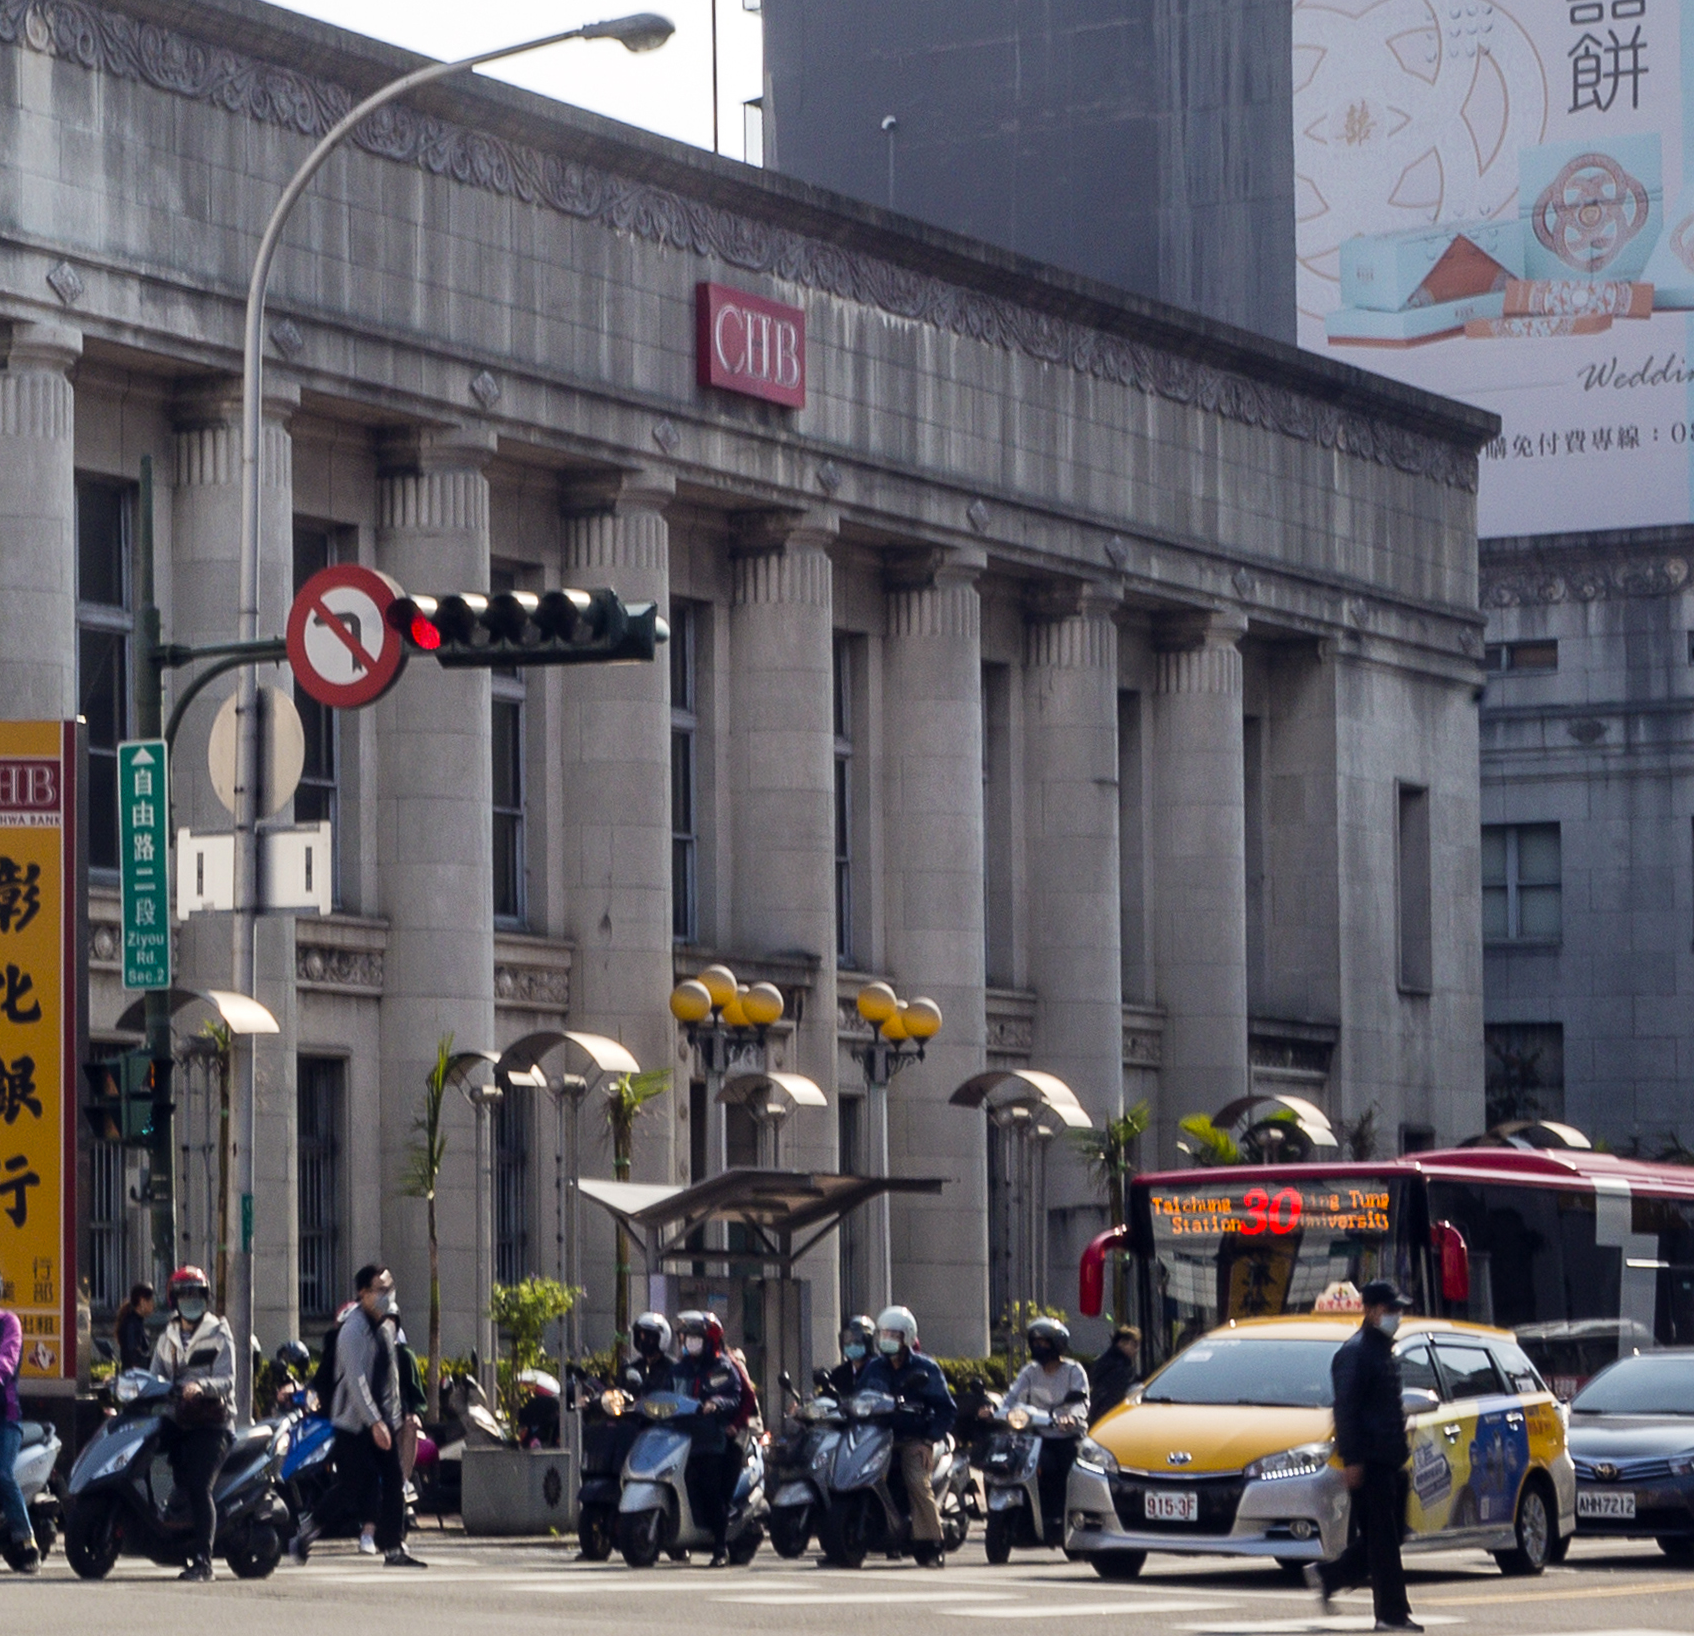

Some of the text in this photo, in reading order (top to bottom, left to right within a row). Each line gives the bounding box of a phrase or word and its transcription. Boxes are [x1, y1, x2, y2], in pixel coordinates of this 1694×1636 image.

[715, 304, 800, 389] CHB
[0, 815, 25, 826] HWA
[30, 815, 61, 825] BANK
[131, 768, 157, 927] 自由路二段
[127, 930, 165, 951] Ziyou
[136, 950, 157, 965] Rd.
[1151, 1196, 1232, 1215] Taichung
[1348, 1189, 1391, 1211] Tung
[1240, 1186, 1303, 1236] 30
[1171, 1215, 1243, 1235] Station
[1146, 1496, 1195, 1516] 915-3F
